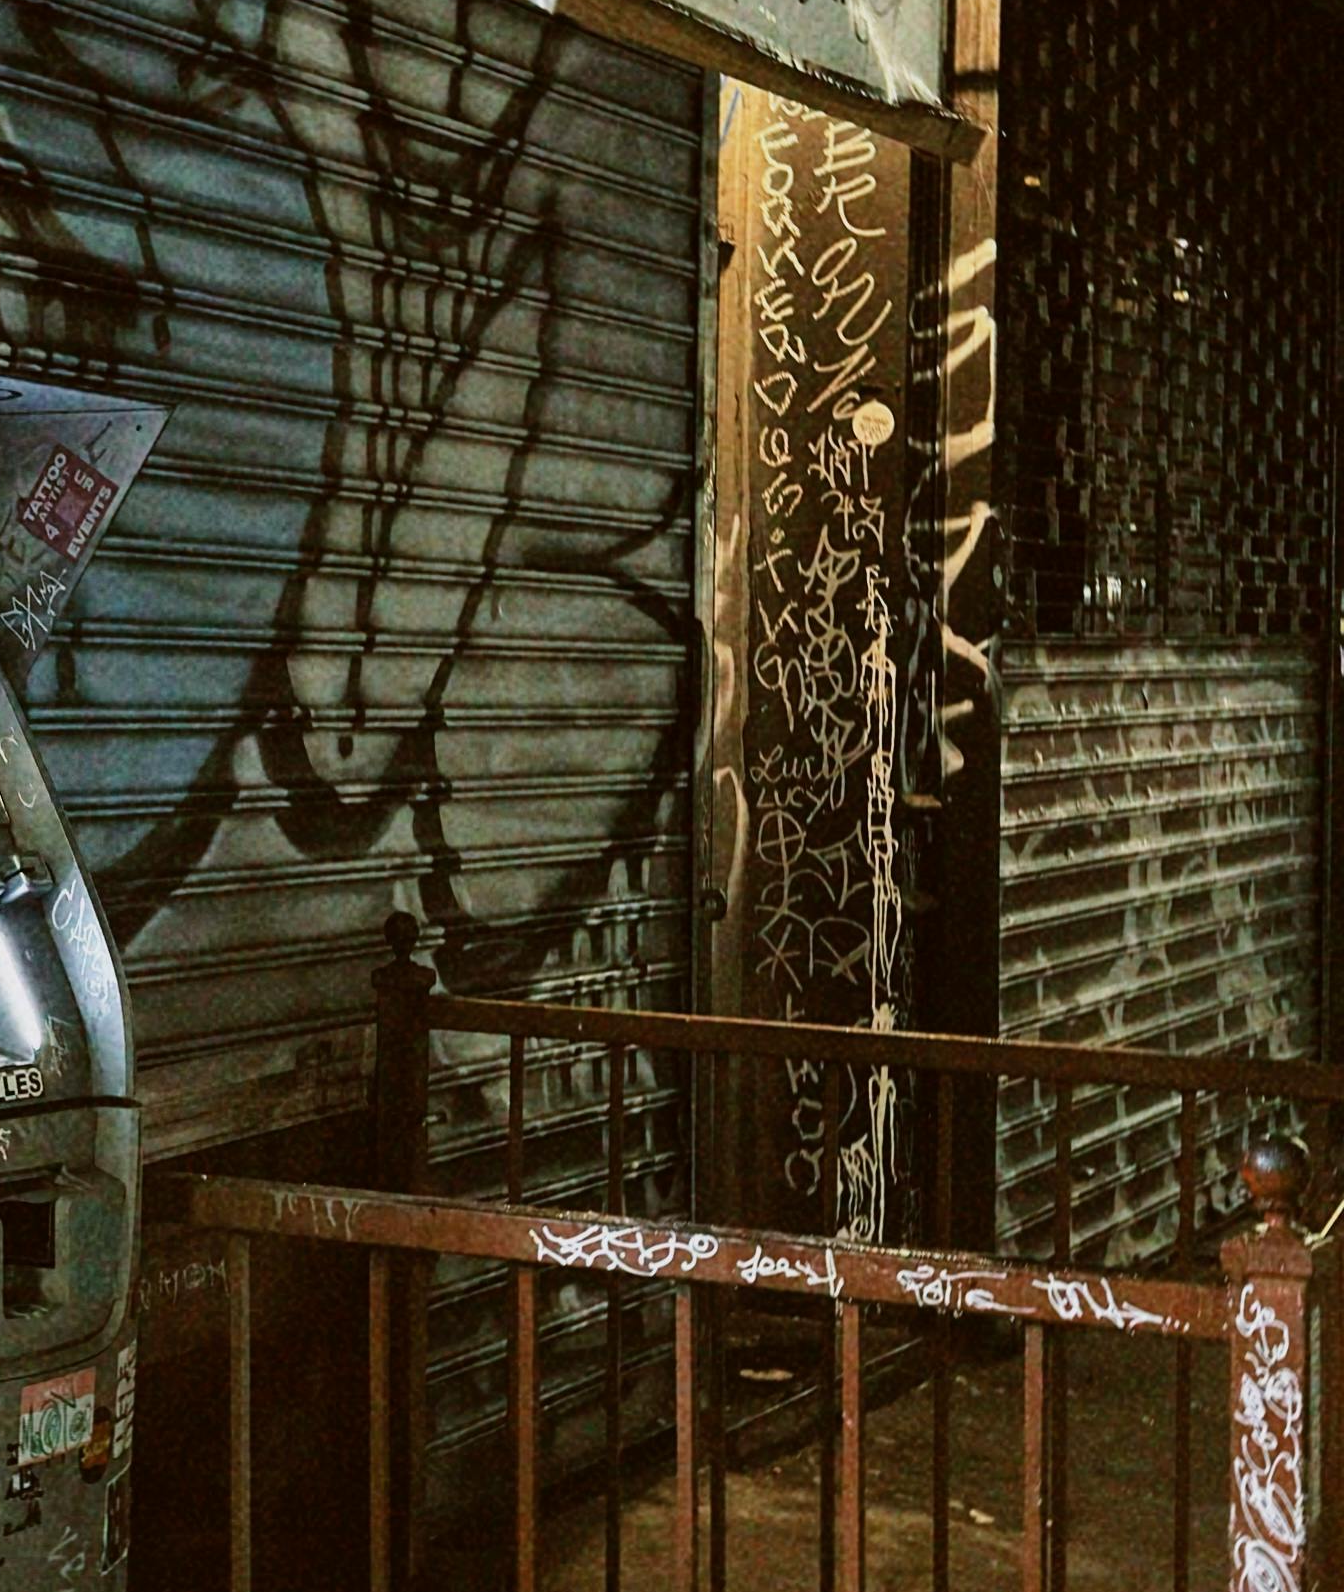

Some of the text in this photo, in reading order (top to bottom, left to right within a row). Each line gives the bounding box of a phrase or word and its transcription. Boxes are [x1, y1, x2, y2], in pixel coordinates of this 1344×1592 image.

[23, 453, 67, 522] TATTOO
[38, 467, 71, 524] ARTIST
[66, 486, 113, 559] EVENTS
